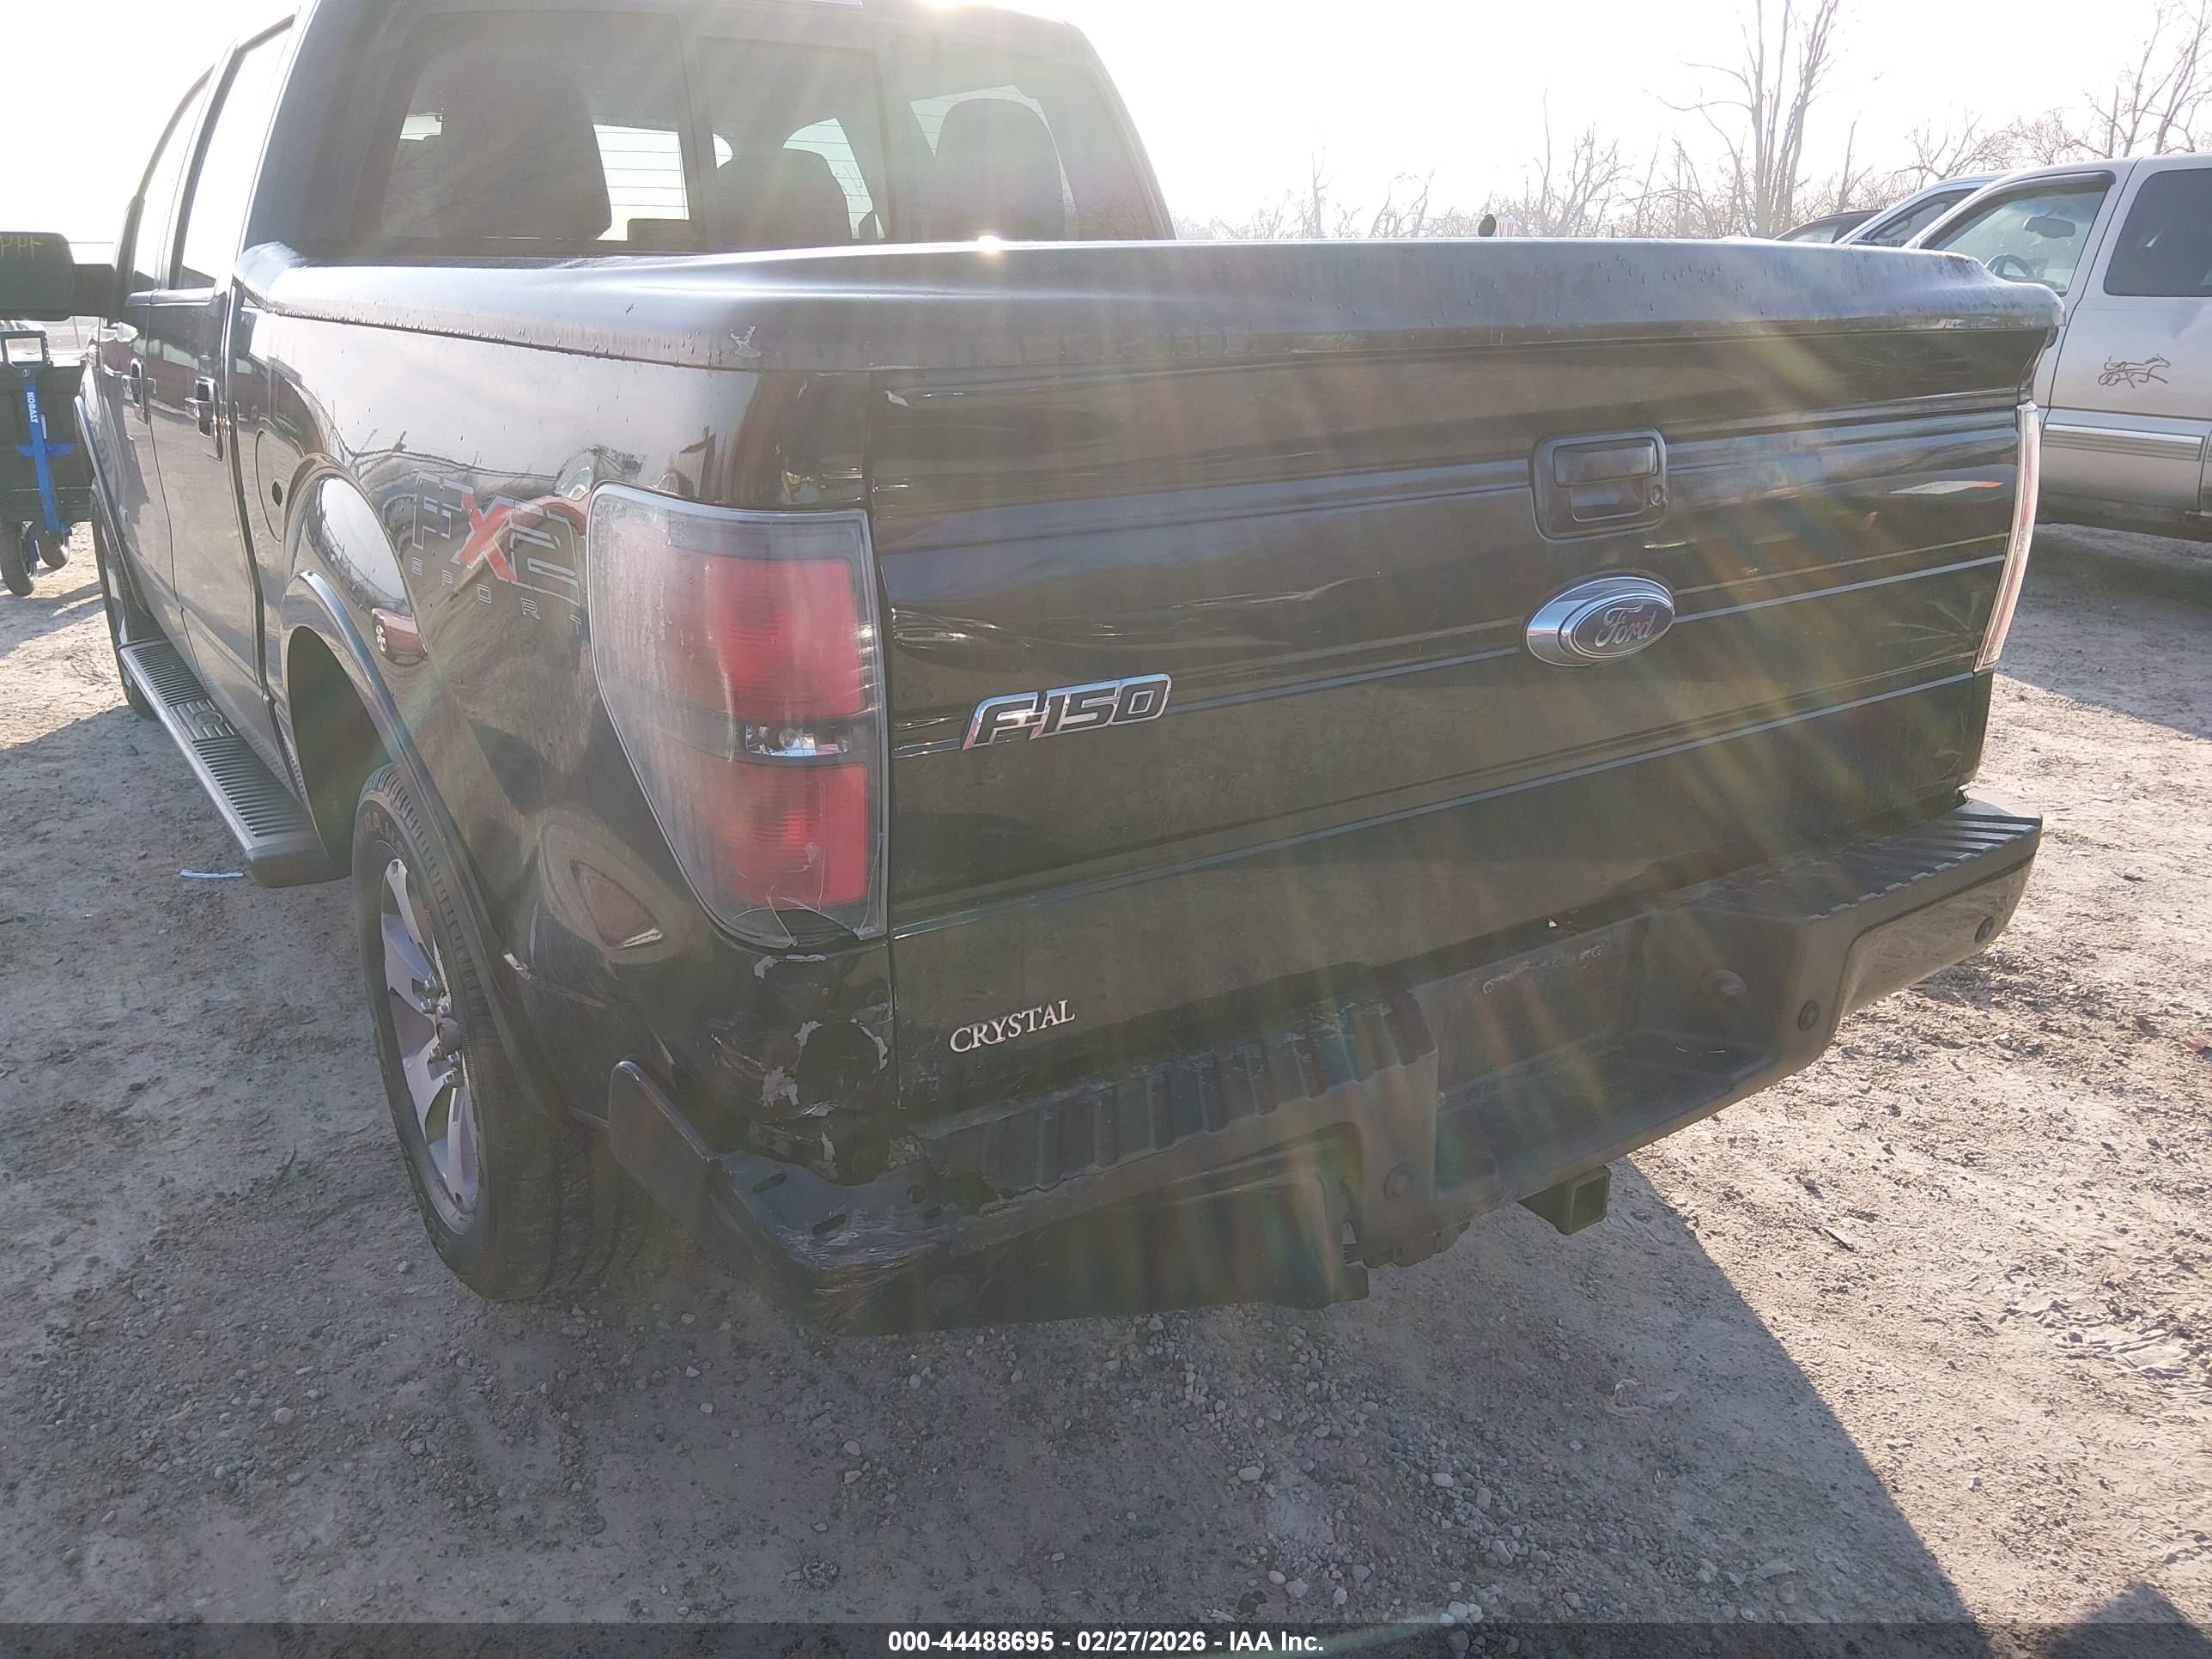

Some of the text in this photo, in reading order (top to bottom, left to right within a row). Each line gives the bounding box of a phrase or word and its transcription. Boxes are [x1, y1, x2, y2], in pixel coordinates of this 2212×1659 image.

[27, 392, 39, 424] KOBALT
[1595, 605, 1658, 647] Ford
[963, 673, 1172, 750] F-150
[949, 999, 1077, 1054] CRYSTAL
